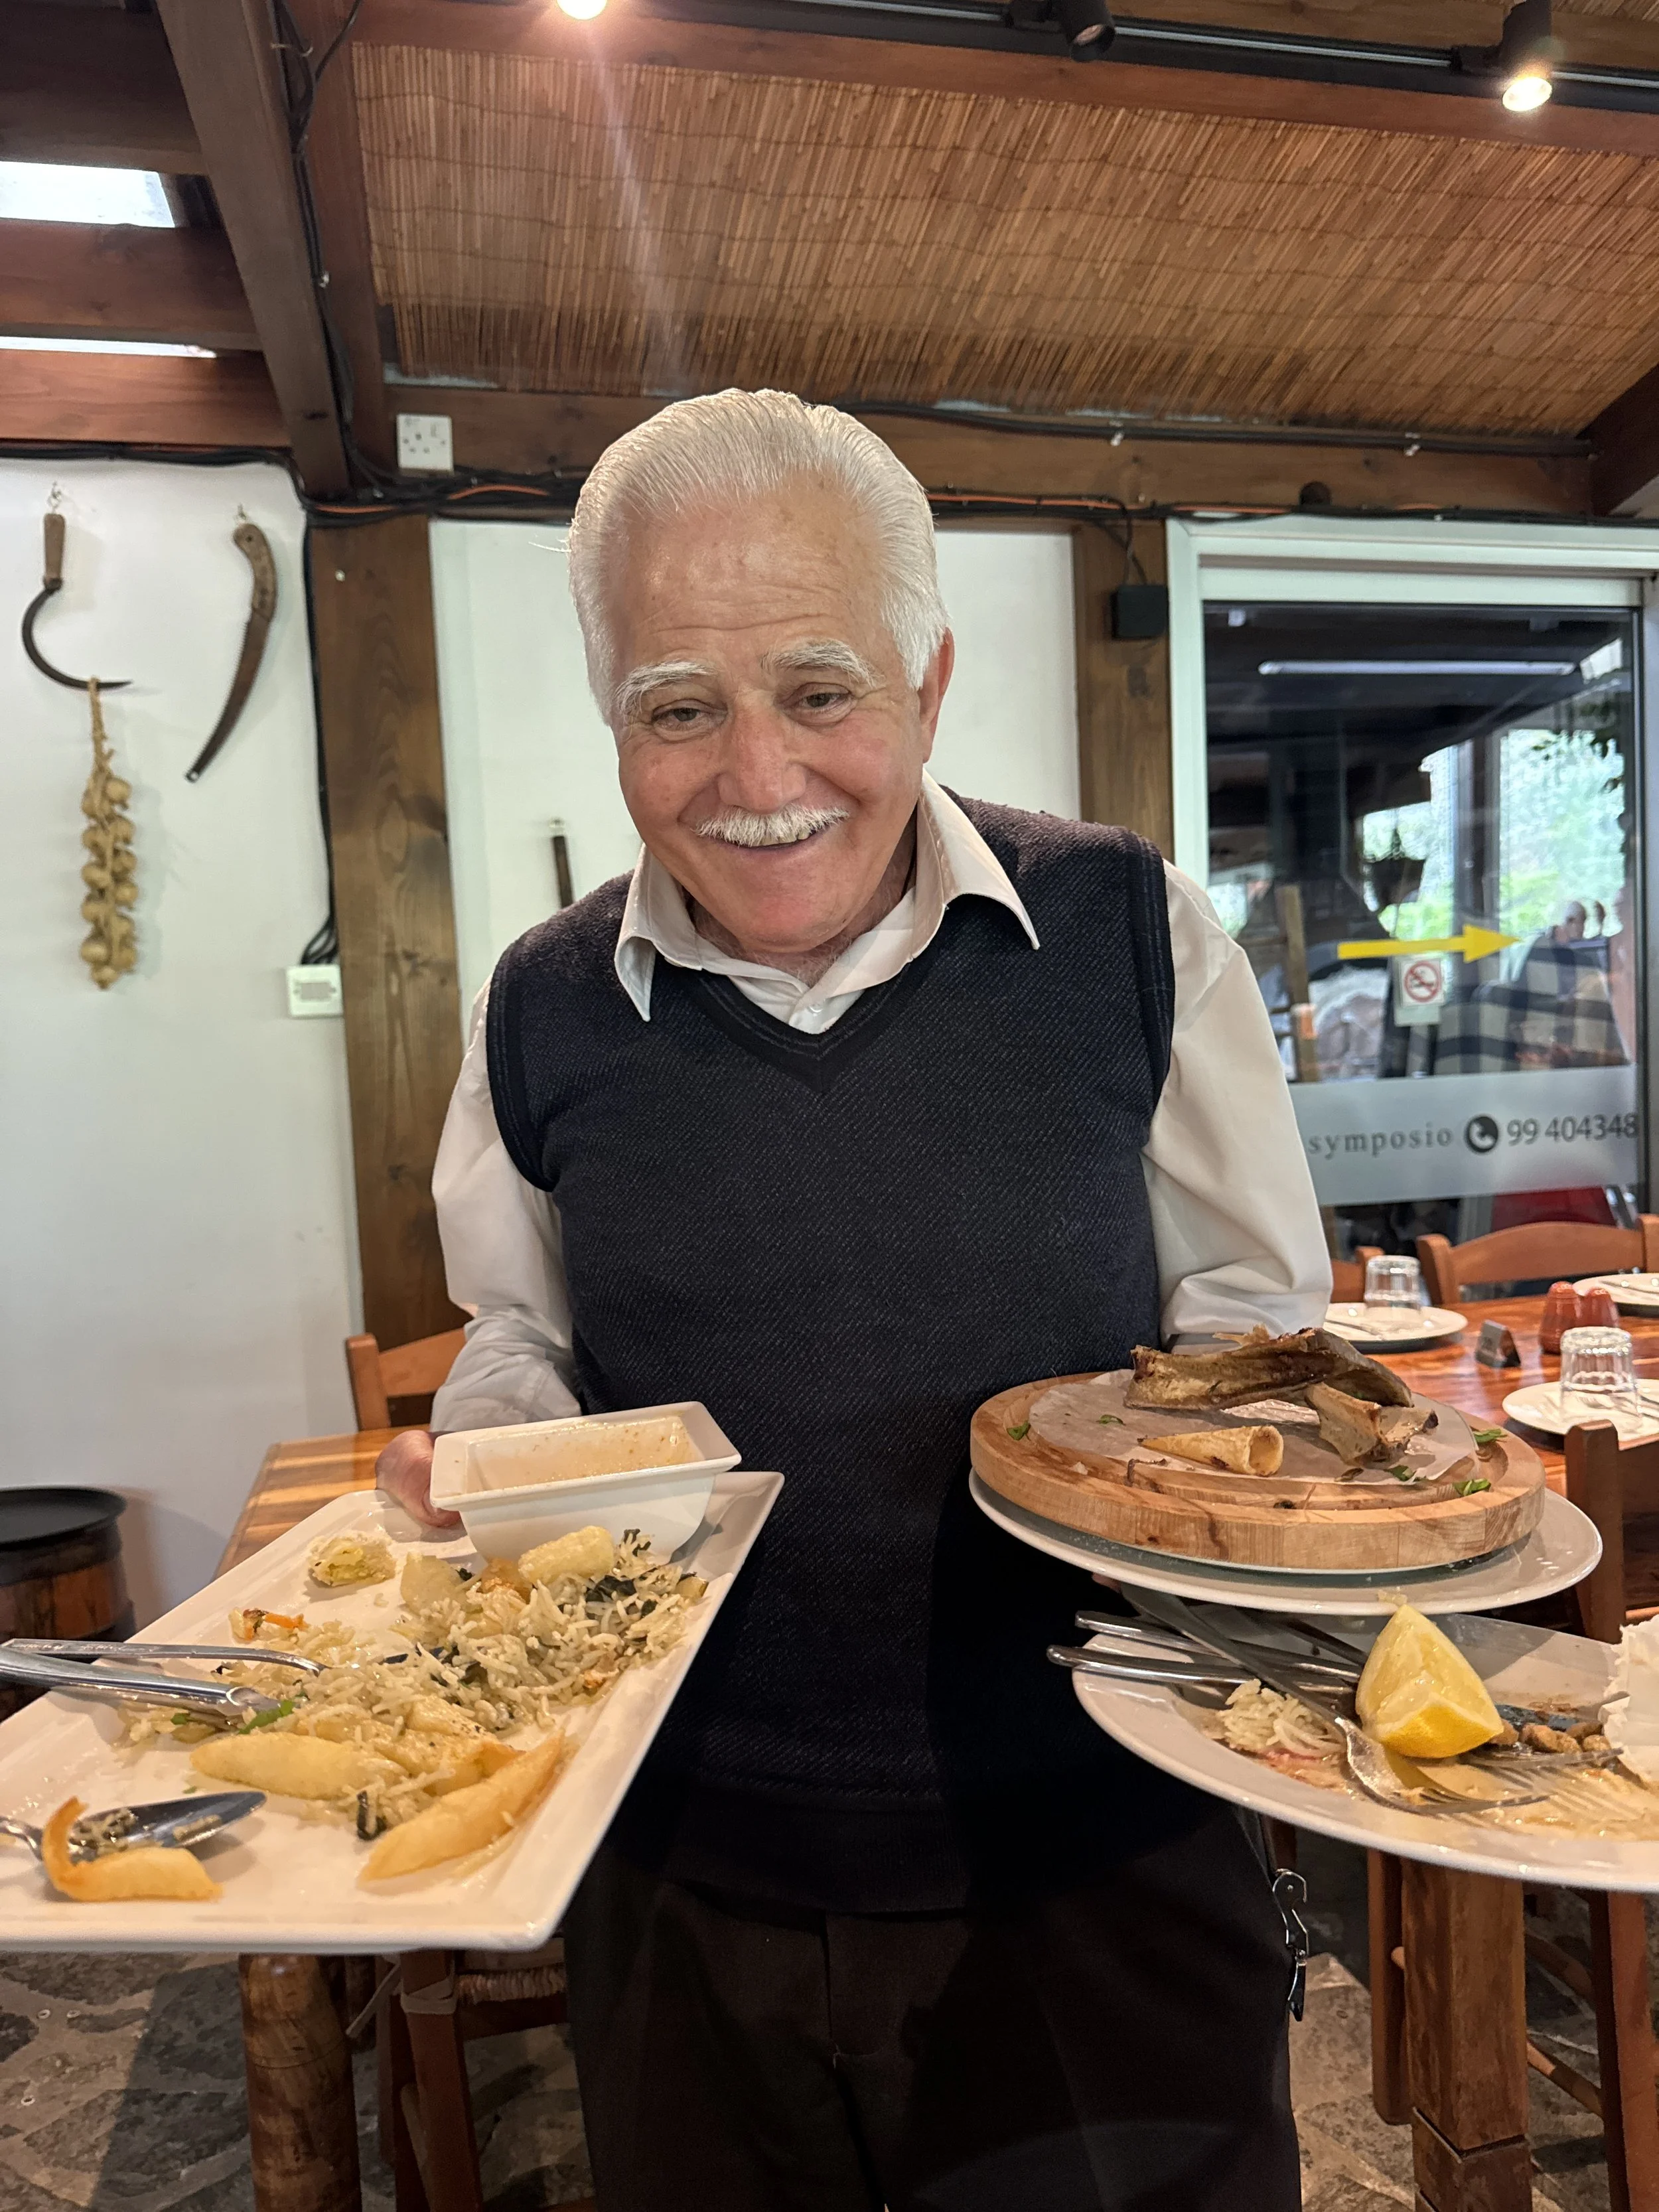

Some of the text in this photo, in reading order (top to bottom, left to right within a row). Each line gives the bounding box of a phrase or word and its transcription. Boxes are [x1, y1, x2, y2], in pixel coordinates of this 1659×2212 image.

[1308, 1113, 1638, 1160] symposio 99 404348
